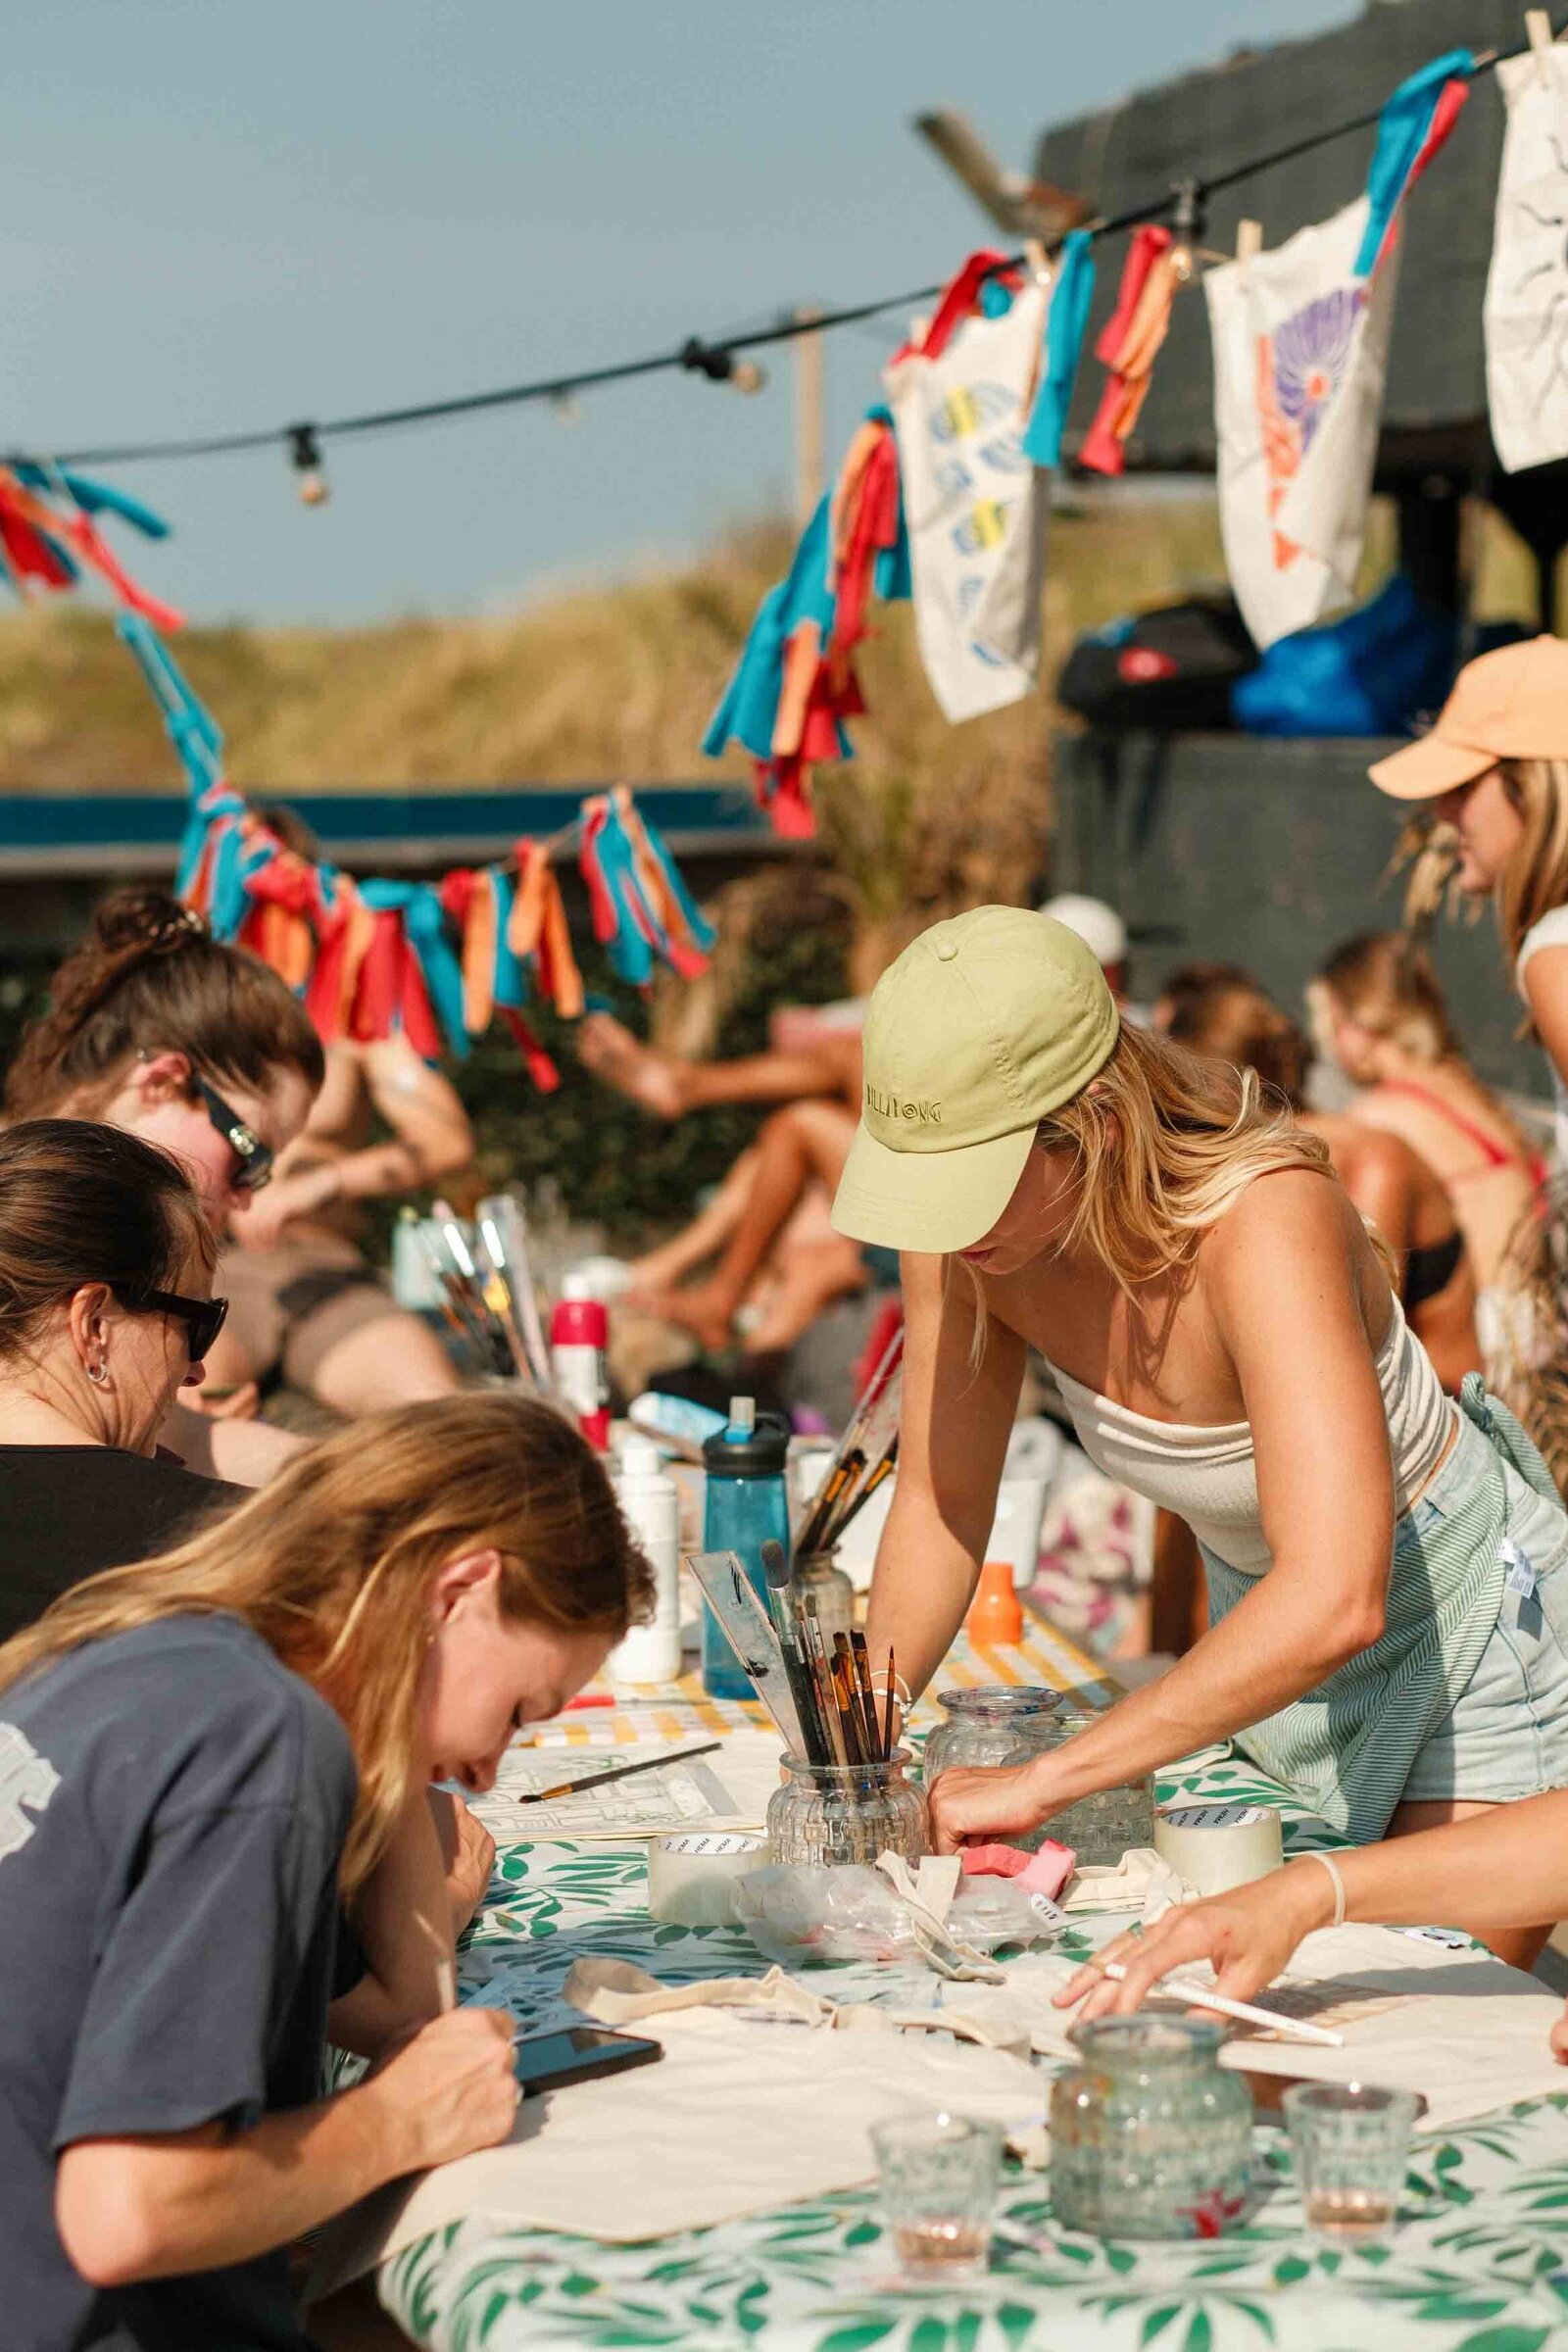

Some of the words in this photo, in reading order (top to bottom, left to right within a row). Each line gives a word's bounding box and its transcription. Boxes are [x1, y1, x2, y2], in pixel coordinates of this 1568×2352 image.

[1194, 1809, 1209, 1827] HEMA
[1213, 1807, 1230, 1825] HEMA
[694, 1838, 710, 1854] HEMA
[715, 1838, 731, 1854] HEMA
